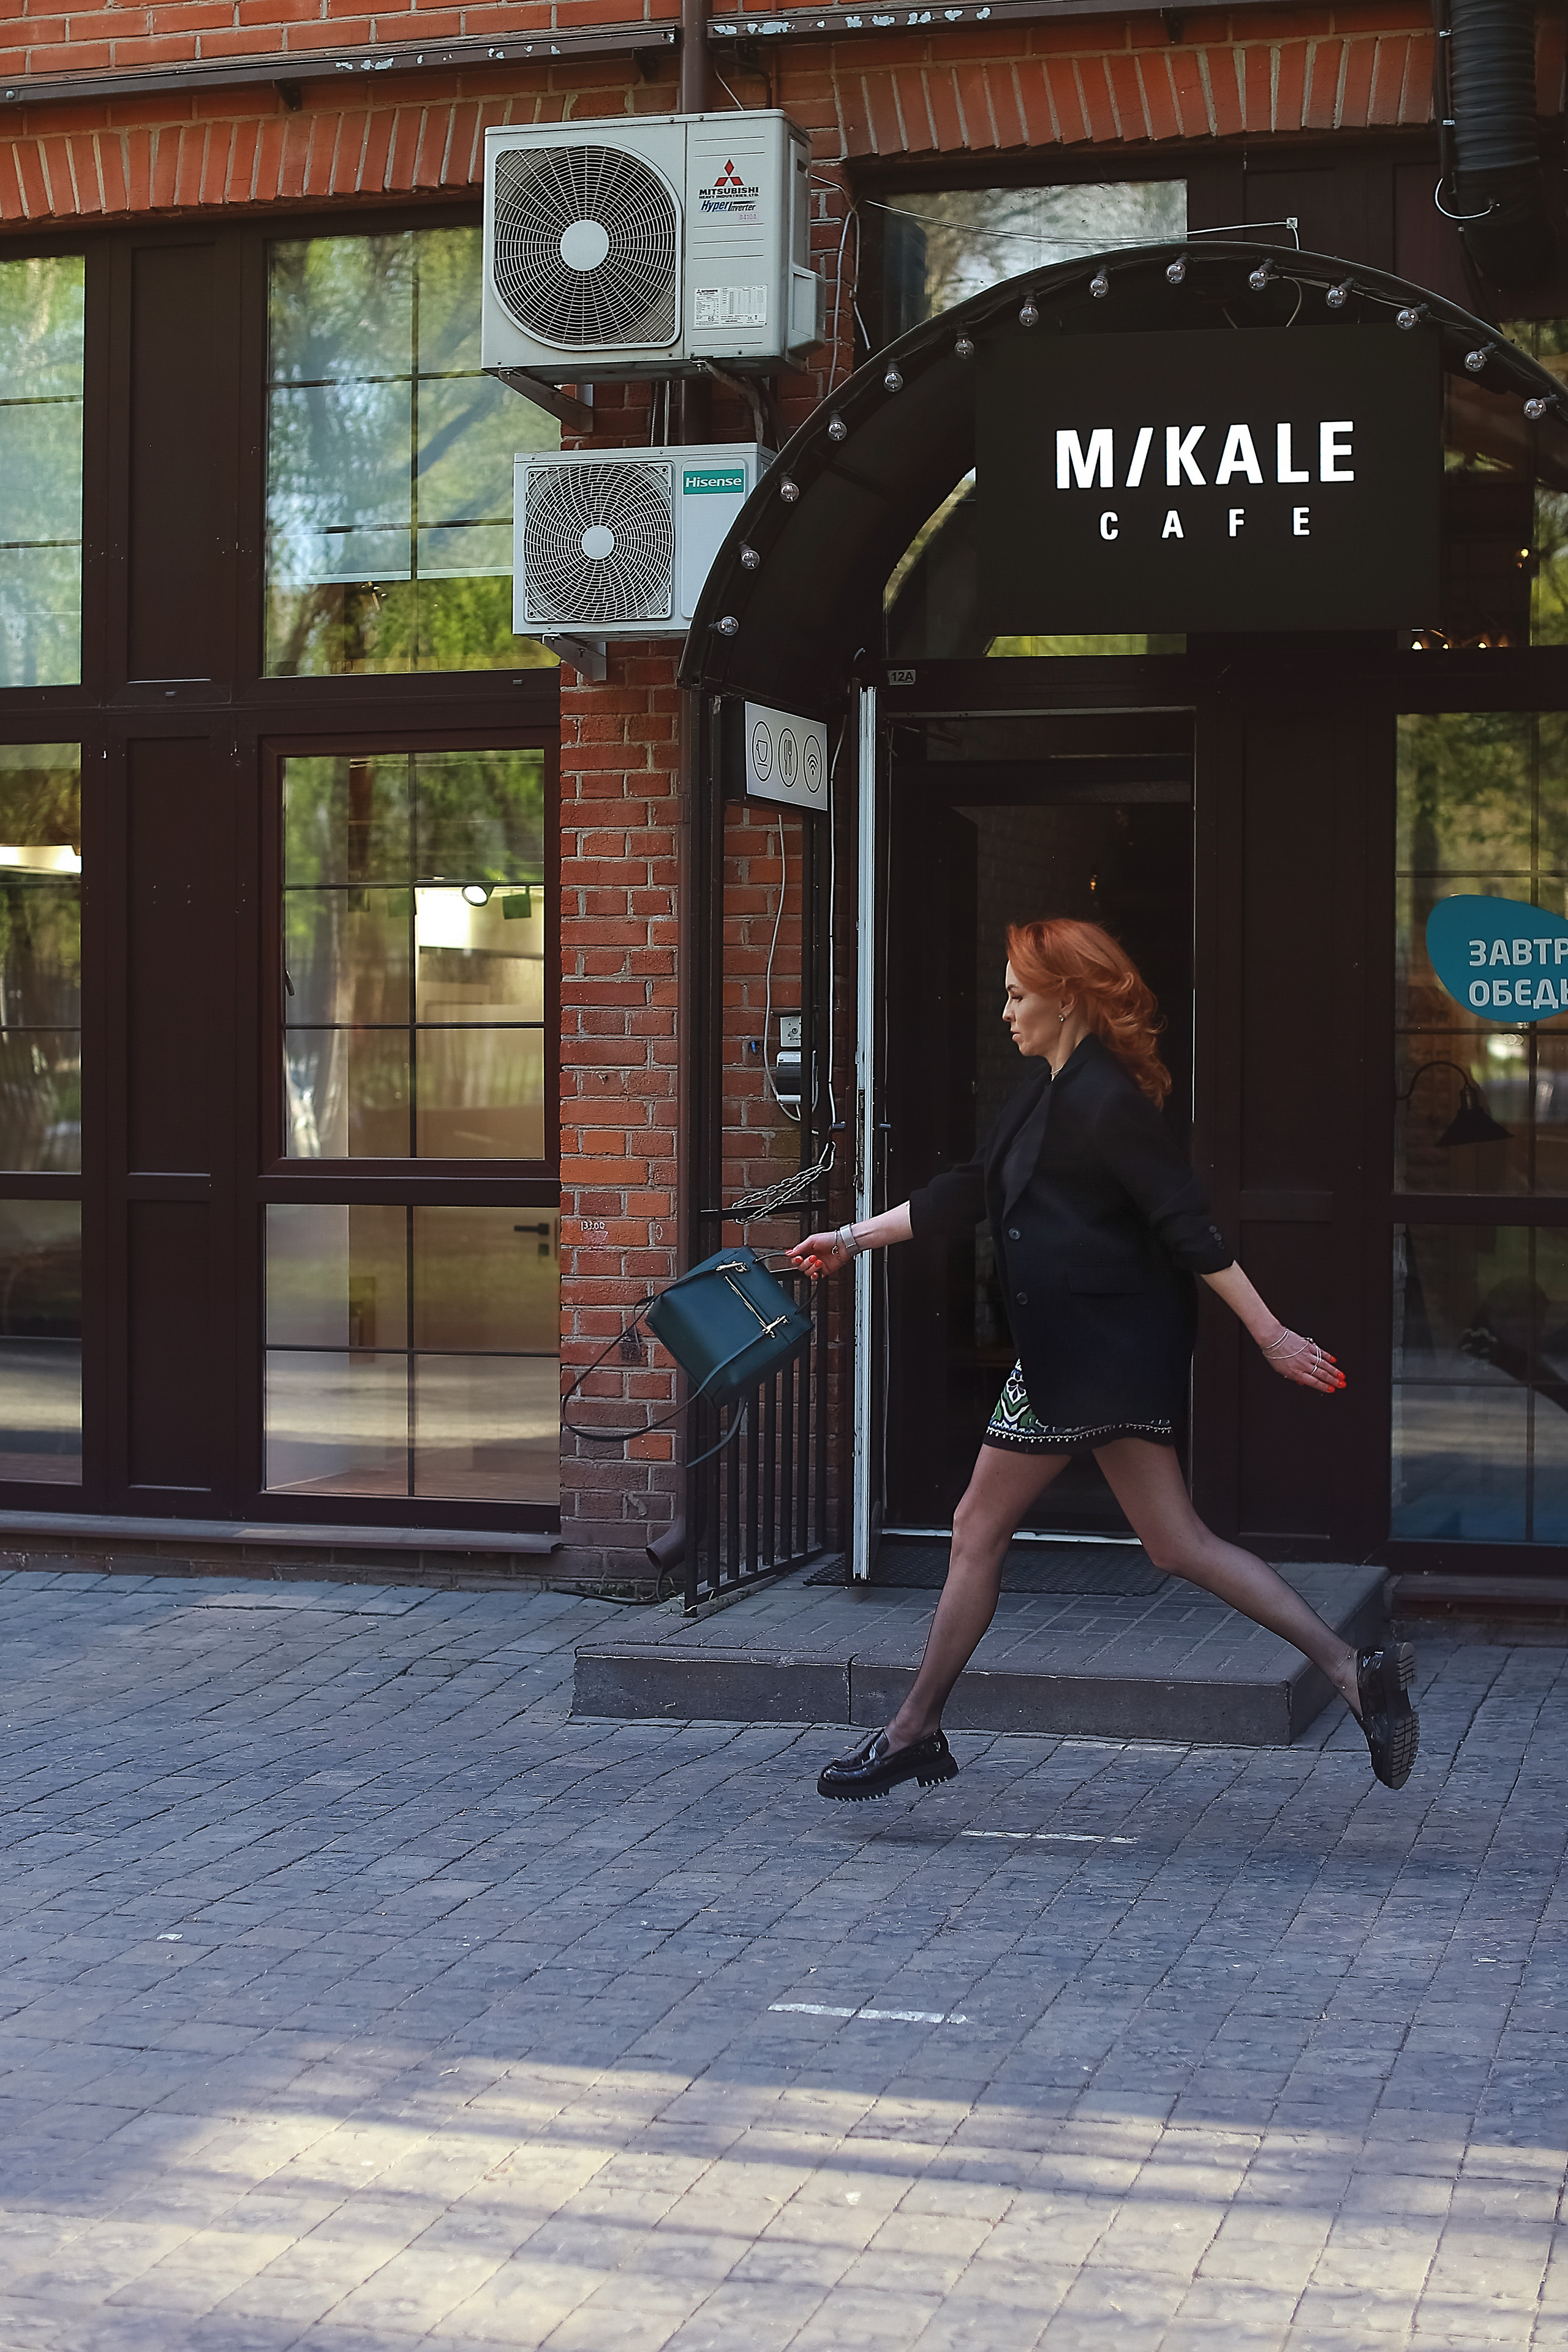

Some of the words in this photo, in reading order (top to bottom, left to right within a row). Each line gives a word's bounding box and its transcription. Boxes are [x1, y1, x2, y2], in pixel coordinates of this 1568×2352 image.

[699, 187, 759, 195] MITSUBISHI
[701, 200, 729, 213] Hyper
[728, 201, 756, 211] Inverter
[1056, 421, 1354, 489] M/KALE
[685, 477, 742, 488] Hisense
[1100, 507, 1310, 540] CAFE
[891, 671, 914, 682] 12A
